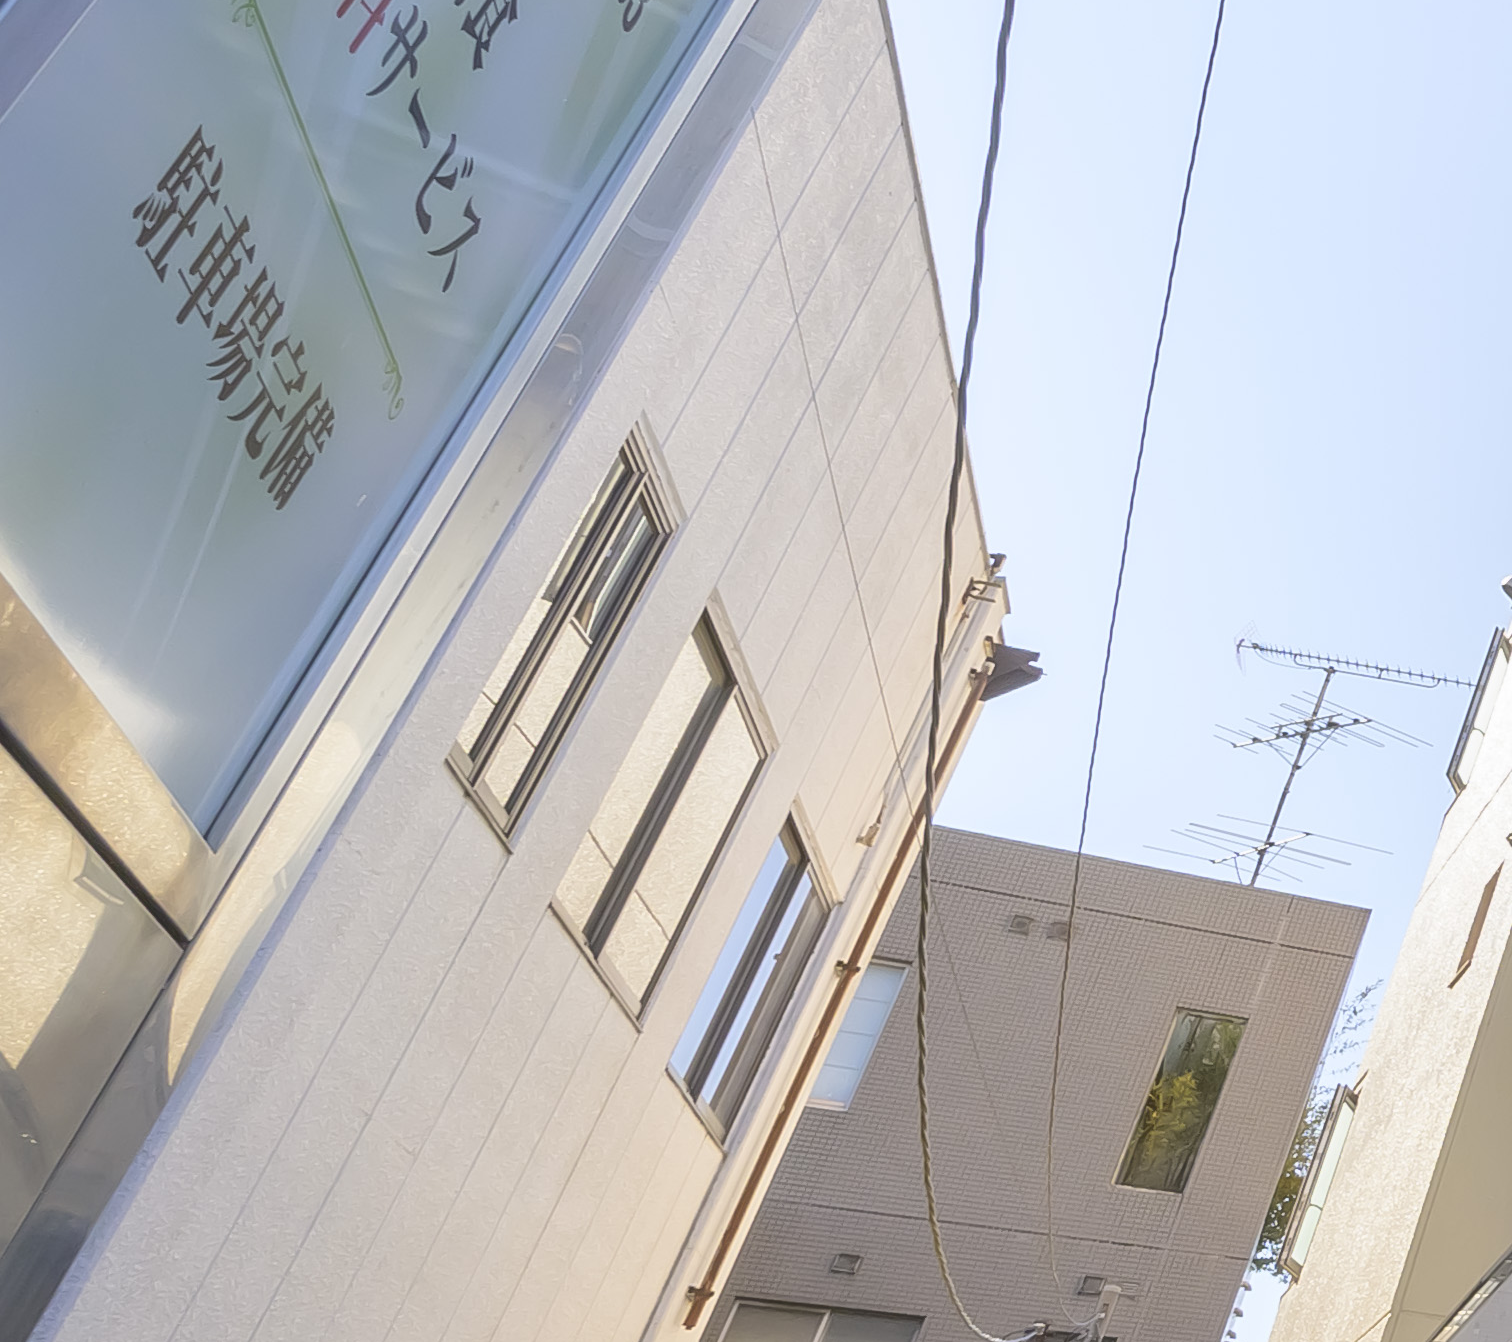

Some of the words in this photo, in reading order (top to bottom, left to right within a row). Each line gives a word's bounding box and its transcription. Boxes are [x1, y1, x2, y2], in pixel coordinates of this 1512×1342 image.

[132, 124, 336, 511] 駐車場完備
